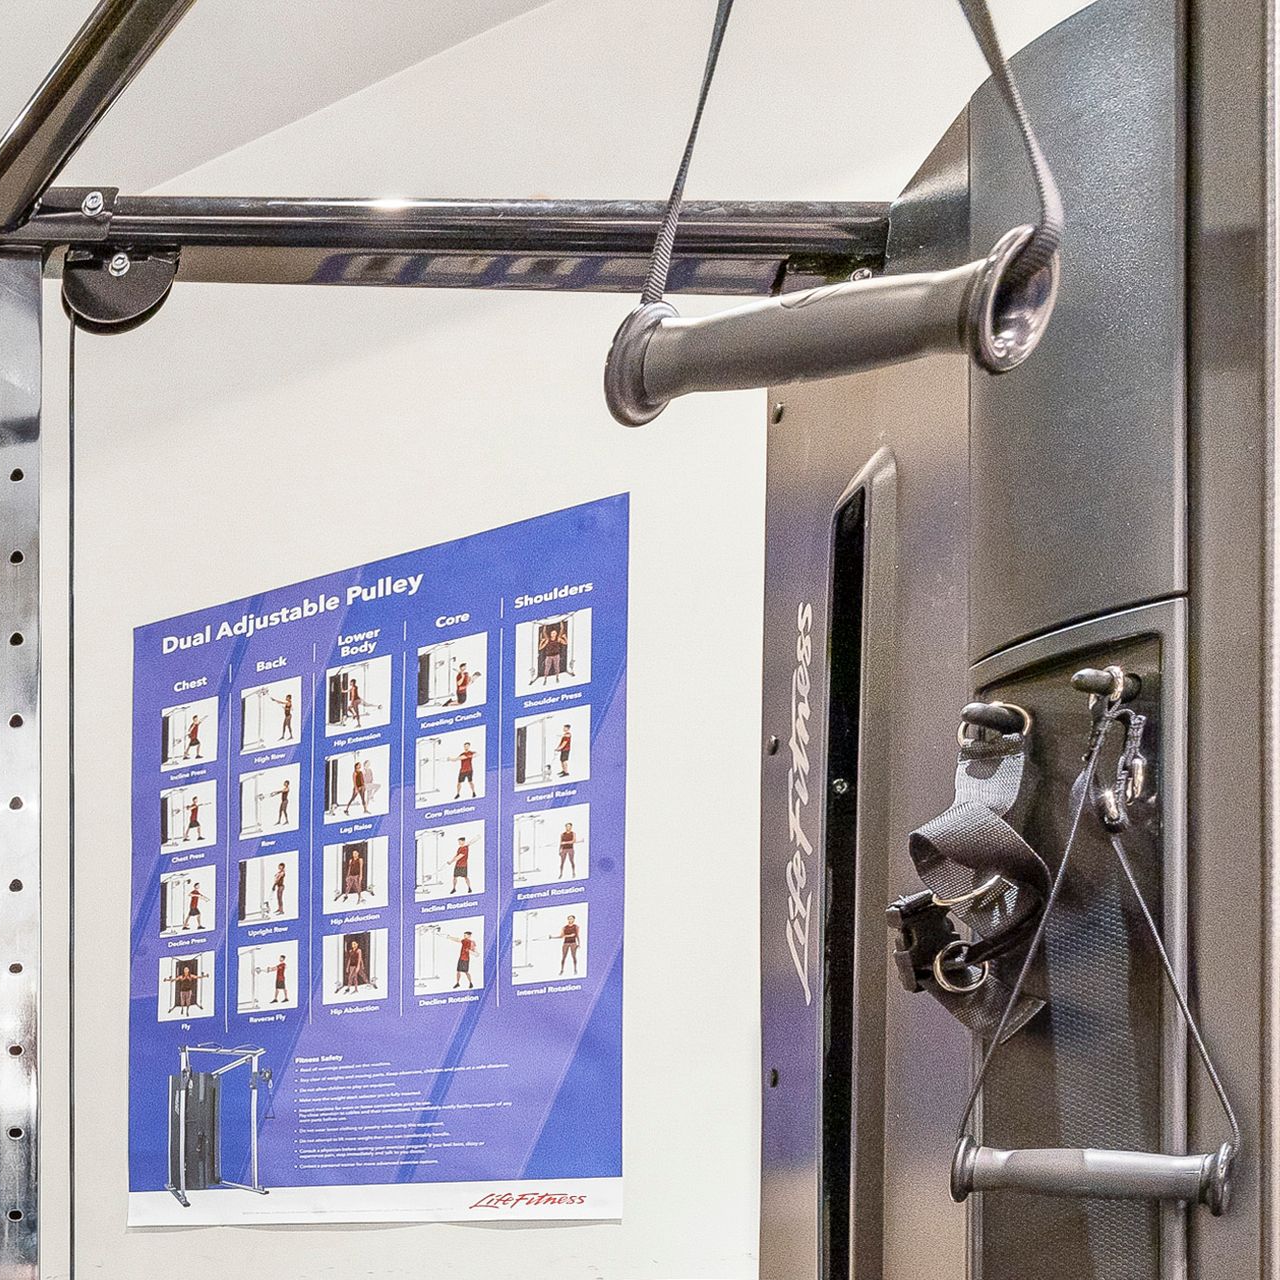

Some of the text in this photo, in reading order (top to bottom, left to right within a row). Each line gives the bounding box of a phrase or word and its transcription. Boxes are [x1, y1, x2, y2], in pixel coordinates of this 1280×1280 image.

[514, 582, 593, 608] Shoulders
[163, 574, 424, 654] Dual Adjustable Pulley
[436, 613, 470, 628] Core
[338, 629, 380, 646] Lower
[341, 641, 377, 657] Body
[256, 656, 287, 672] Back
[174, 676, 207, 692] Chest
[524, 692, 582, 708] Shoulder Press
[420, 711, 482, 729] Kneeling Crunch
[347, 733, 381, 744] Extension
[254, 755, 269, 763] High
[526, 792, 554, 802] Lateral
[444, 806, 475, 816] Rotation
[517, 886, 584, 900] External Rotation
[447, 901, 478, 910] Rotation
[344, 914, 380, 923] Adduction
[248, 928, 273, 937] Upright
[517, 984, 581, 996] Internal Rotation
[448, 995, 479, 1004] Rotation
